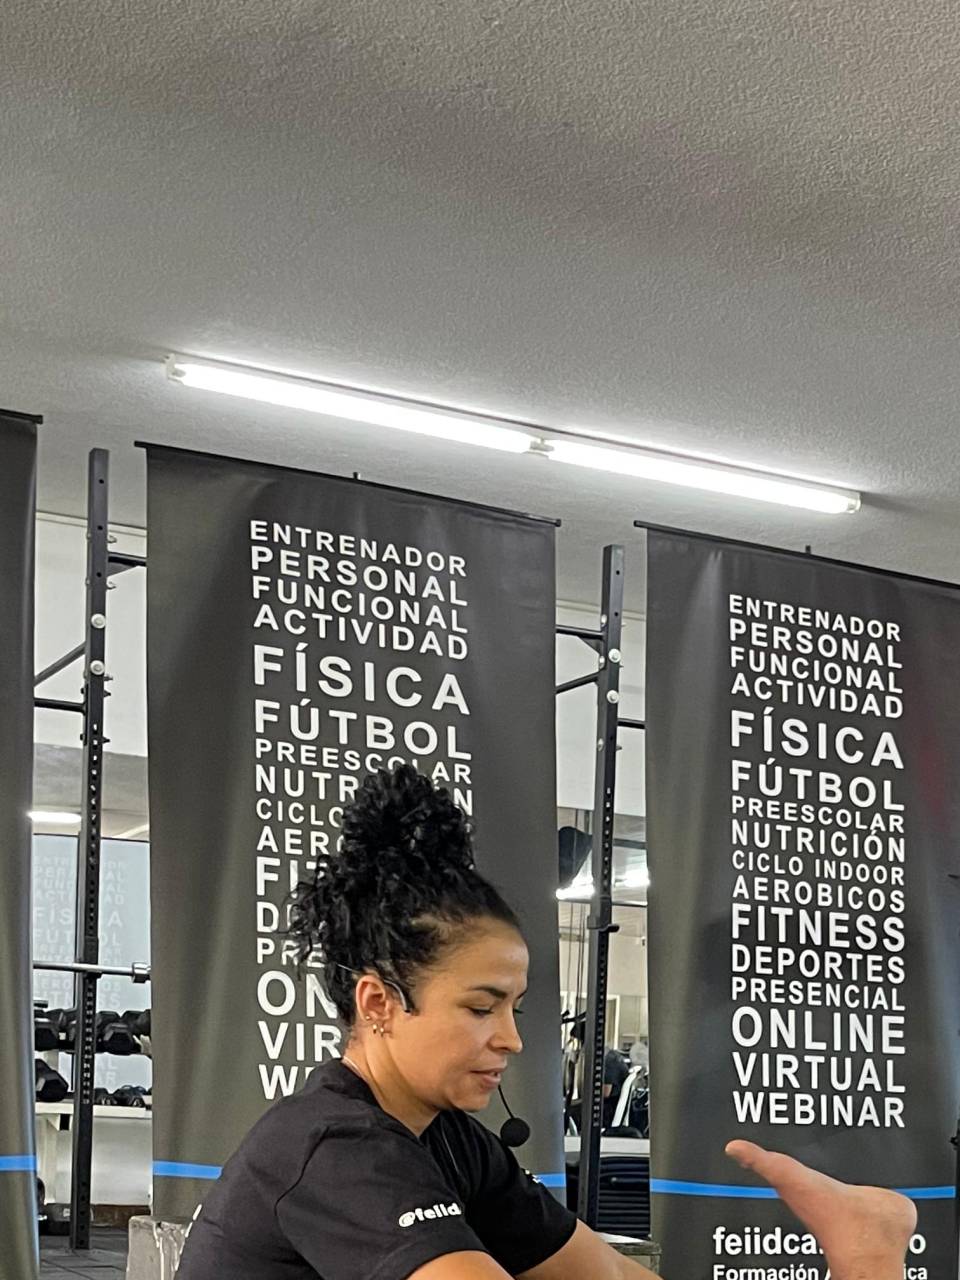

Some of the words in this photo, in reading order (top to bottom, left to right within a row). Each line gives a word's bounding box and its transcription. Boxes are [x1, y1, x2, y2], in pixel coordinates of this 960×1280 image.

[250, 520, 467, 577] ENTRENADOR
[251, 545, 468, 607] PERSONAL
[252, 575, 468, 634] FUNCIONAL
[729, 594, 901, 642] ENTRENADOR
[253, 603, 468, 660] ACTIVIDAD
[729, 617, 903, 669] PERSONAL
[254, 642, 471, 716] FÍSICA
[730, 645, 903, 694] FUNCIONAL
[731, 672, 903, 719] ACTIVIDAD
[255, 698, 472, 761] FÚTBOL
[731, 706, 904, 769] FÍSICA
[731, 757, 905, 811] FÚTBOL
[731, 795, 905, 834] PREESCOLAR
[731, 818, 905, 863] NUTRICIÓN
[732, 849, 804, 876] CICLO
[815, 858, 905, 886] INDOOR
[732, 874, 905, 914] AEROBICOS
[732, 902, 905, 952] FITNESS
[732, 943, 905, 985] DEPORTES
[732, 976, 906, 1011] PRESENCIAL
[732, 1006, 906, 1055] ONLINE
[732, 1051, 906, 1093] VIRTUAL
[732, 1090, 906, 1128] WEBINAR
